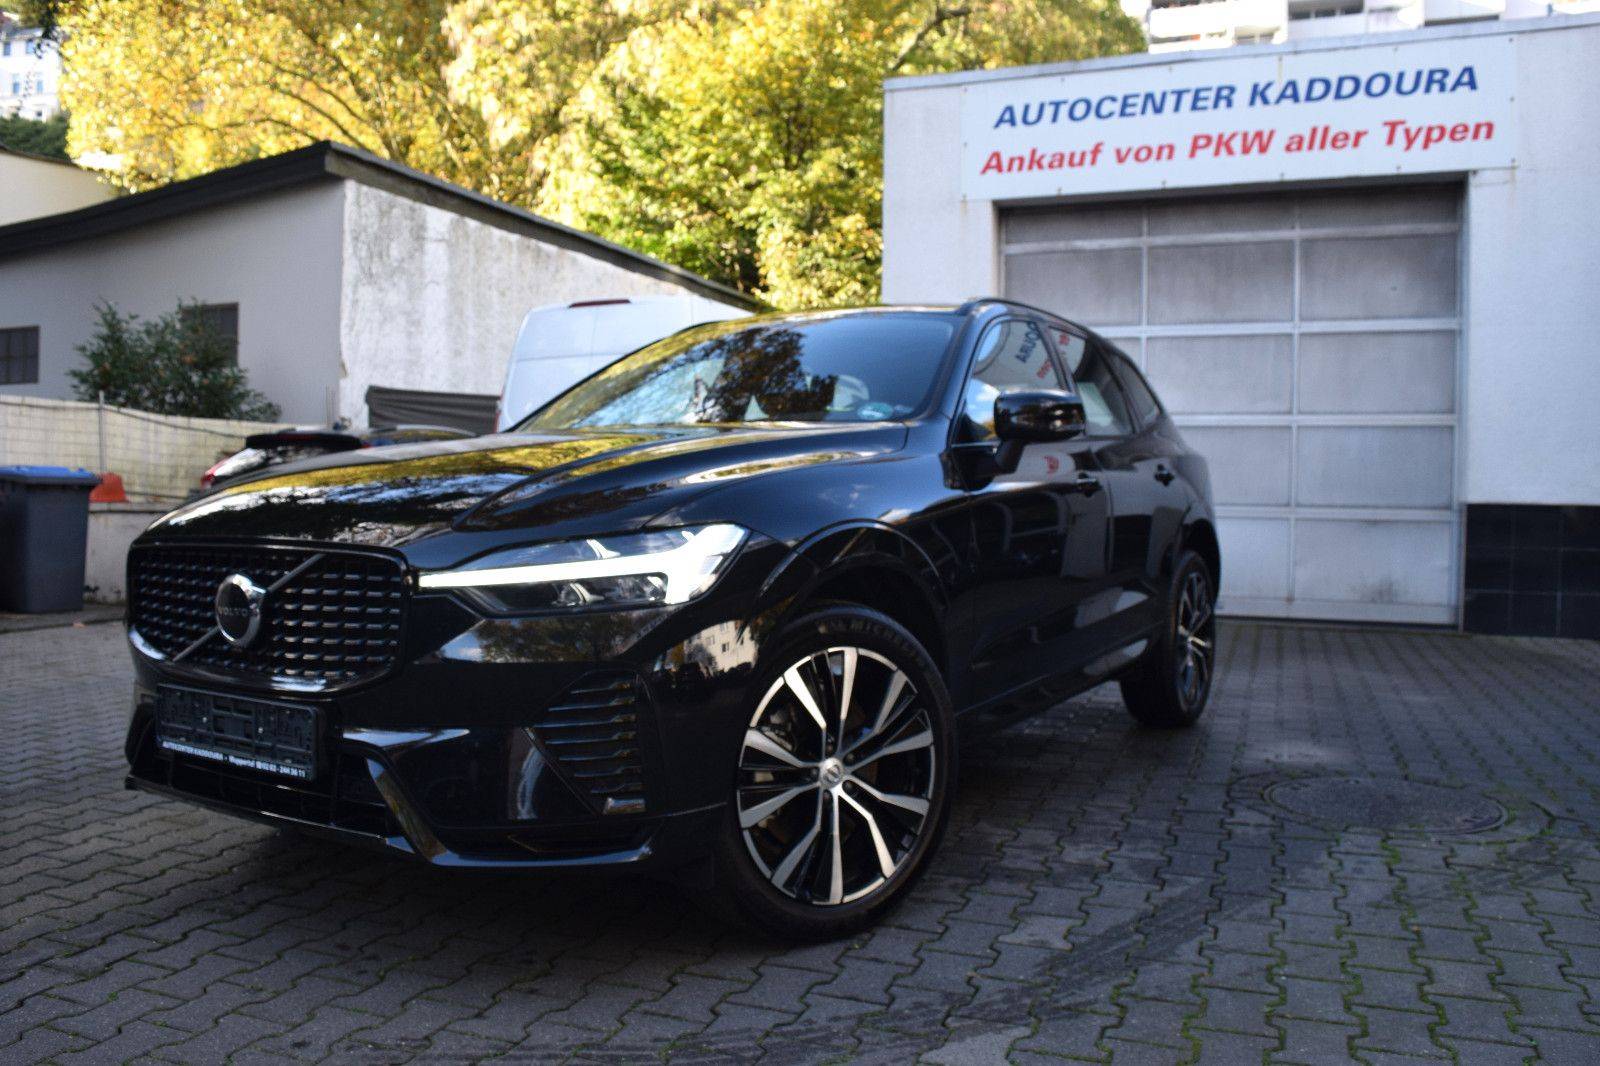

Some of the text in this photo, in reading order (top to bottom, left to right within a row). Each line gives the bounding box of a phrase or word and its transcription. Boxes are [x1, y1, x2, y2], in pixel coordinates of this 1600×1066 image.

[994, 66, 1478, 128] AUTOCENTER KADDOURA
[980, 119, 1495, 174] Ankauf von PKW aller Typen
